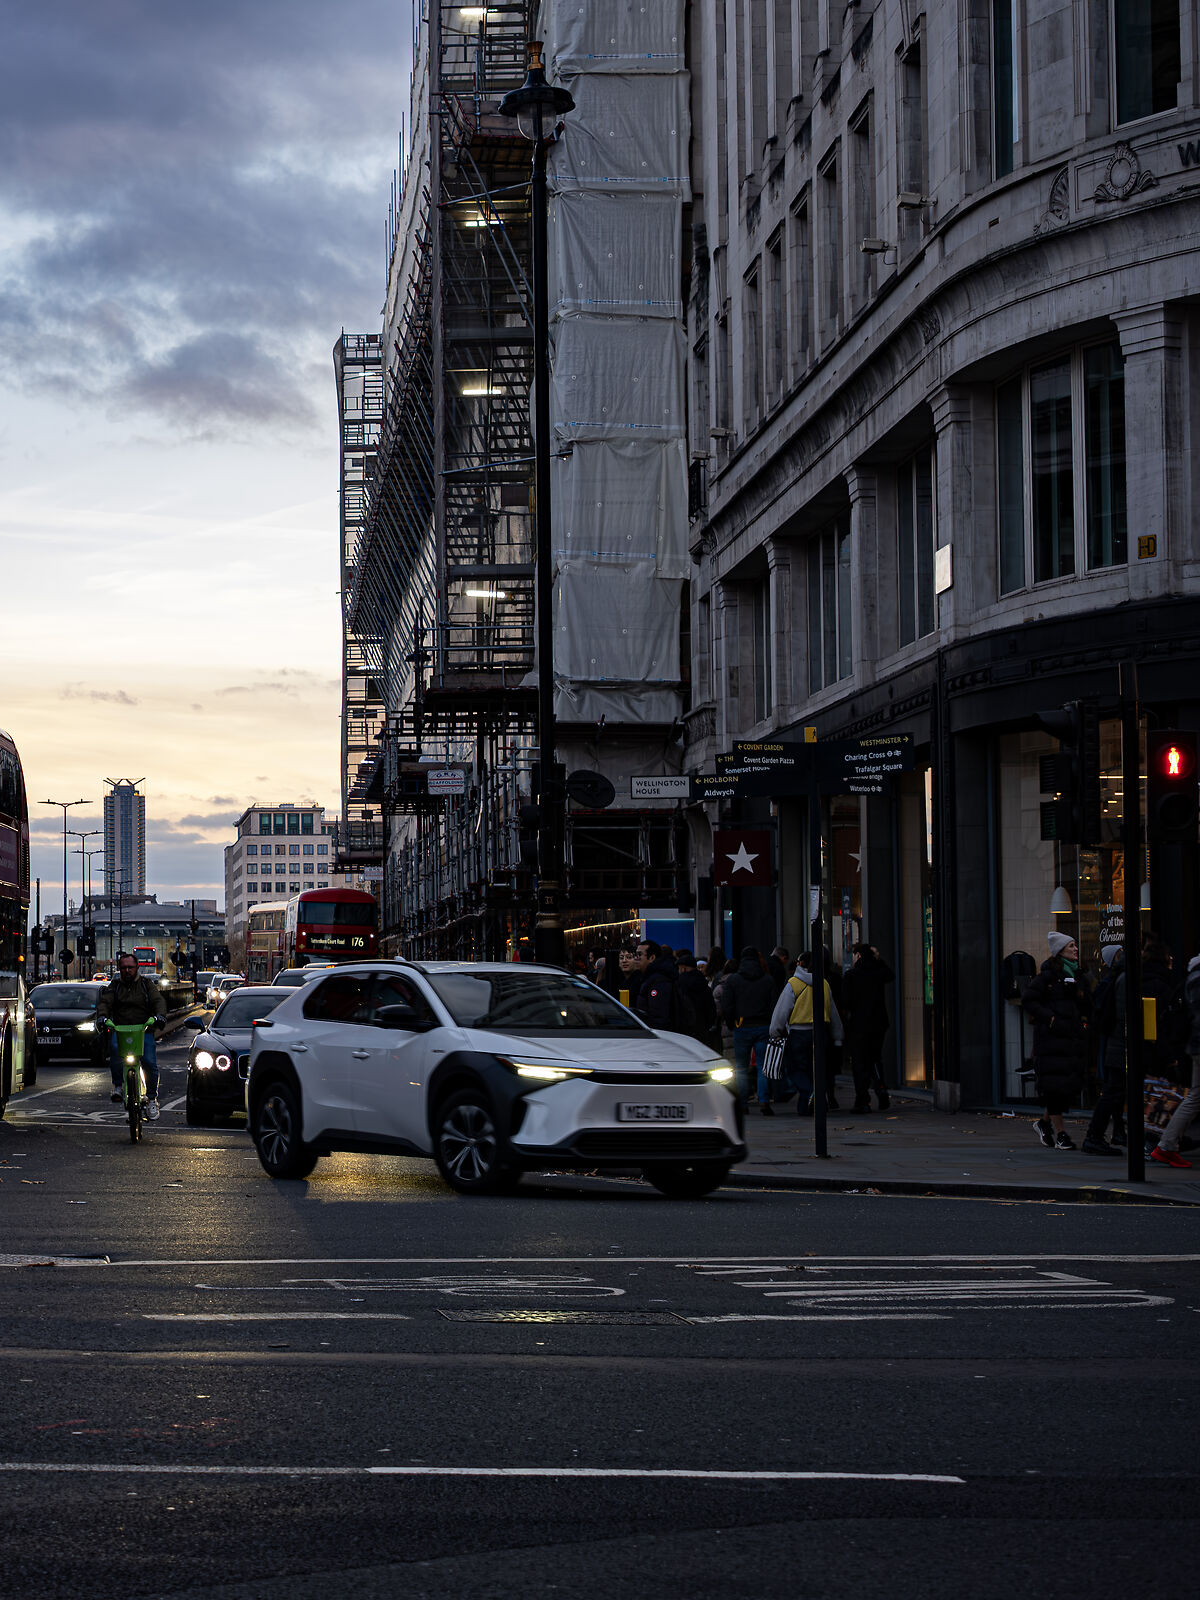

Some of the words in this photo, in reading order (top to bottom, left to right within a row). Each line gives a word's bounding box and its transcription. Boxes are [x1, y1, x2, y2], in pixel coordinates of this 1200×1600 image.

[860, 736, 902, 747] WESTMINSTER
[743, 743, 763, 751] COVENT
[763, 744, 784, 752] GARDEN
[743, 756, 761, 764] Covent
[761, 756, 779, 765] Garden
[779, 757, 795, 765] Piazza
[844, 754, 868, 762] Charing
[868, 752, 886, 760] Cross
[725, 766, 752, 775] Somerset
[855, 765, 881, 774] Trafalgar
[882, 763, 903, 772] Square
[703, 775, 739, 785] HOLBORN
[703, 788, 735, 798] Aldwych
[1107, 917, 1115, 927] of
[1115, 916, 1124, 927] the
[1100, 928, 1125, 943] Christm
[351, 936, 364, 947] 176
